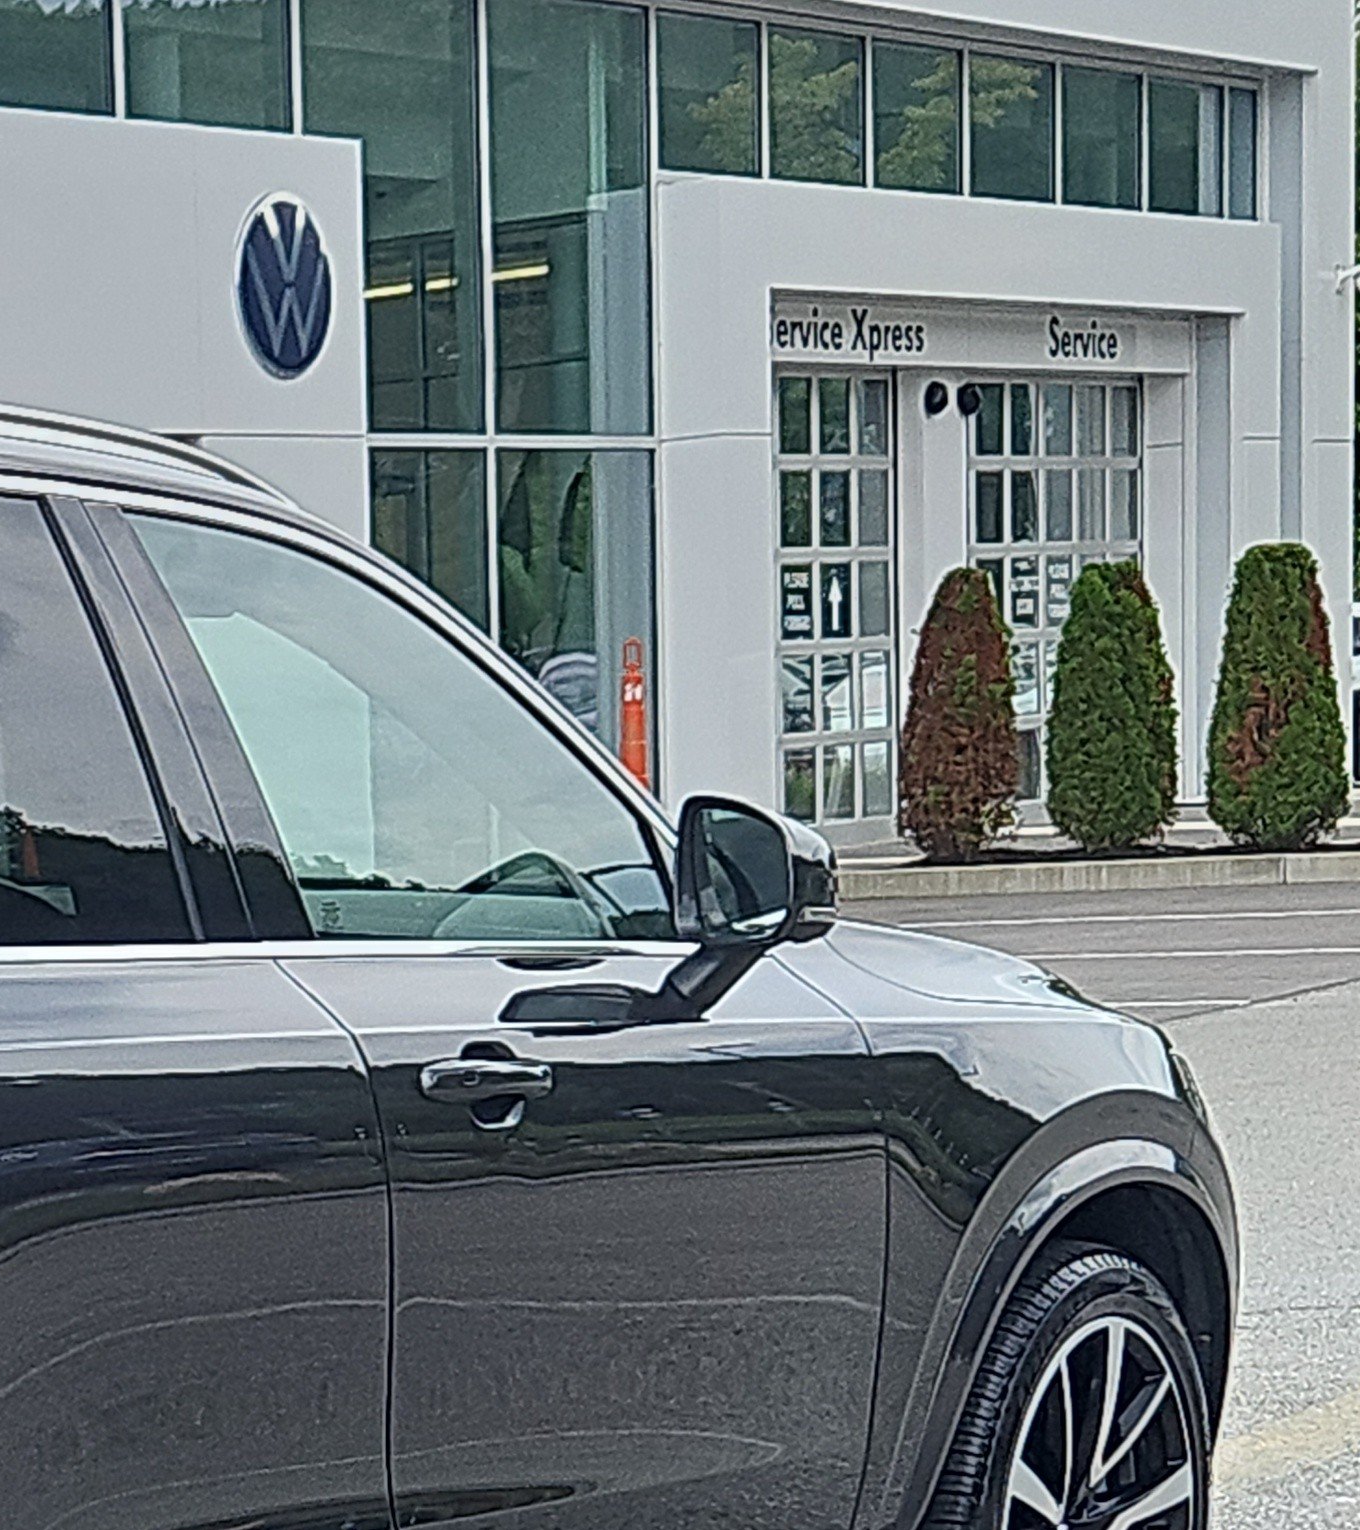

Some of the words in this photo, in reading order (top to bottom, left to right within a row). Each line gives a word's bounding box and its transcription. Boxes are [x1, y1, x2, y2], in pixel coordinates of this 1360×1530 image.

[770, 307, 843, 351] ervice
[850, 308, 925, 361] Xpress
[1048, 314, 1119, 359] Service
